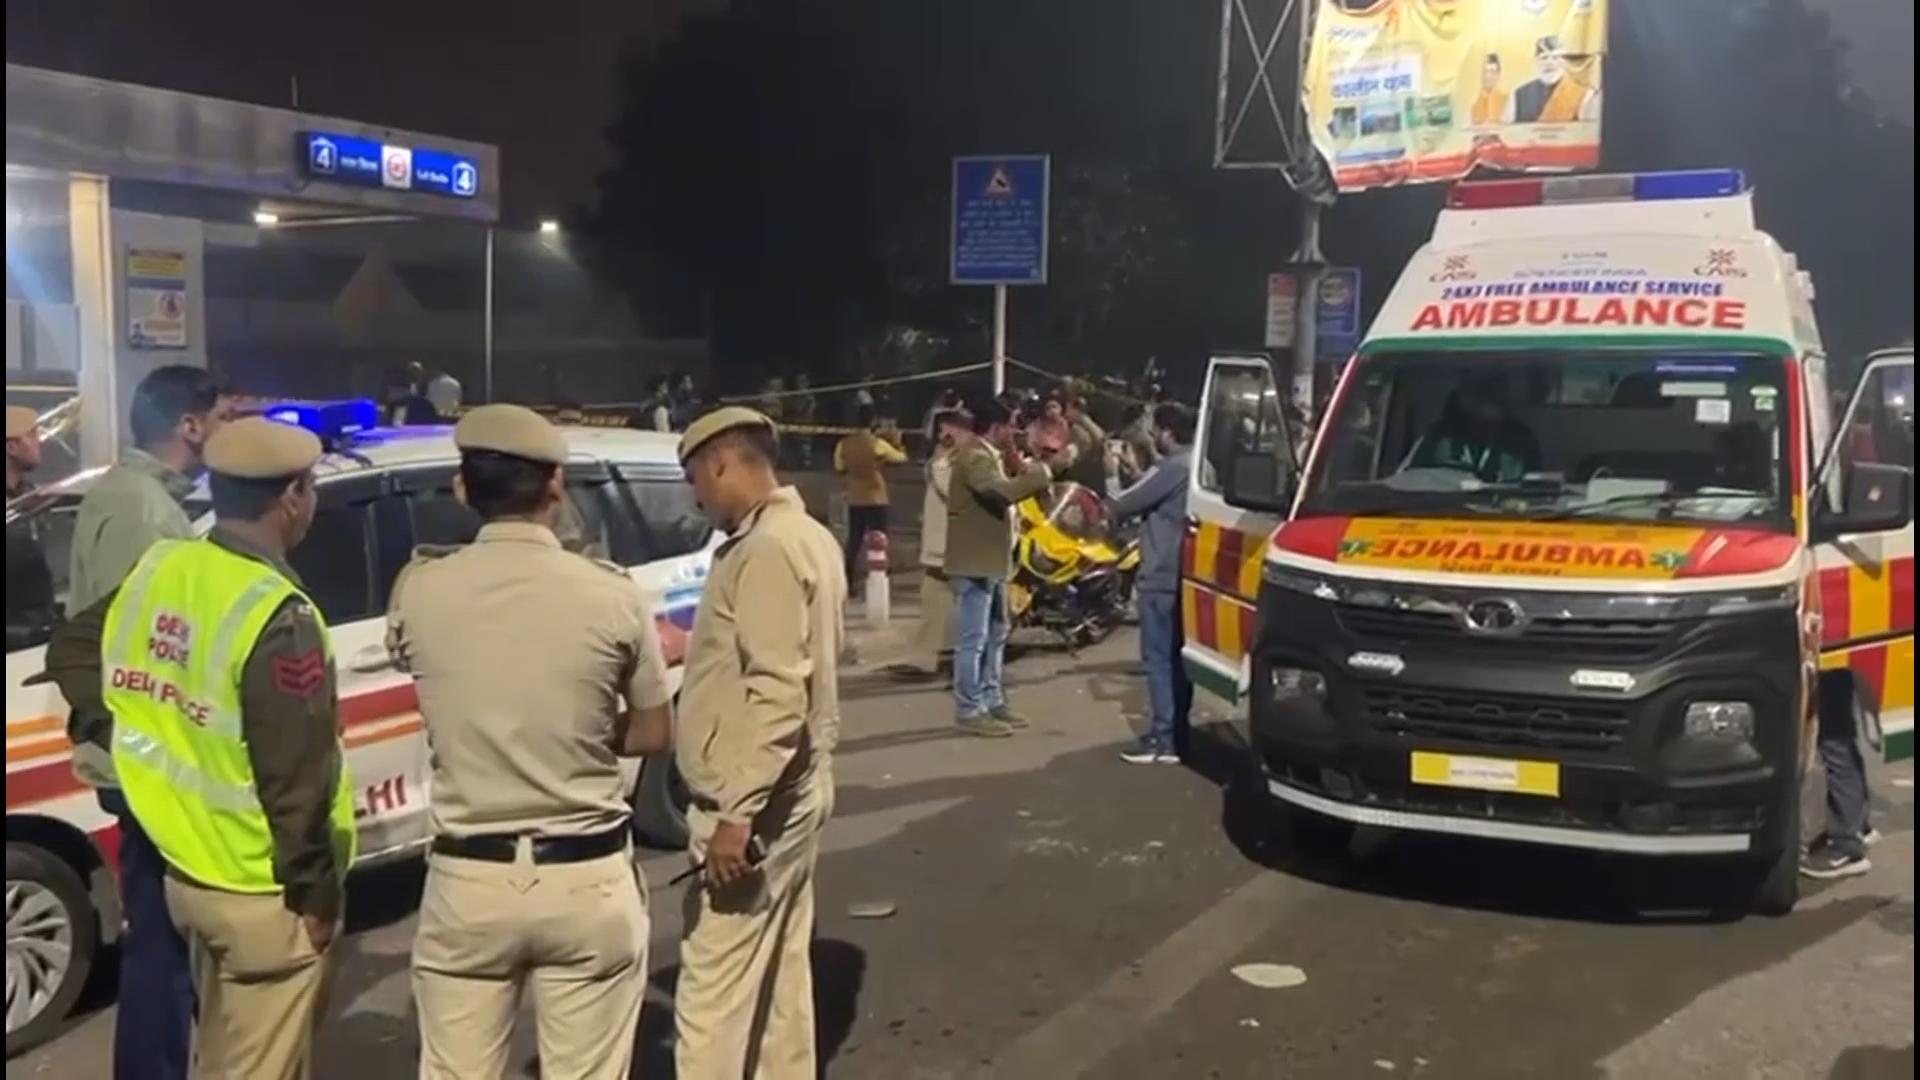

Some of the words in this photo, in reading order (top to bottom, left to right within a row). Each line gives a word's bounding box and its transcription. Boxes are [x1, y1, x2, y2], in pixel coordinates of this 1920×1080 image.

[316, 147, 330, 168] 4
[458, 170, 471, 191] 4
[1484, 283, 1526, 297] FREE
[1528, 280, 1640, 295] AMBULANCE
[1643, 280, 1724, 296] SERVICE
[1410, 298, 1746, 331] AMBULANCE
